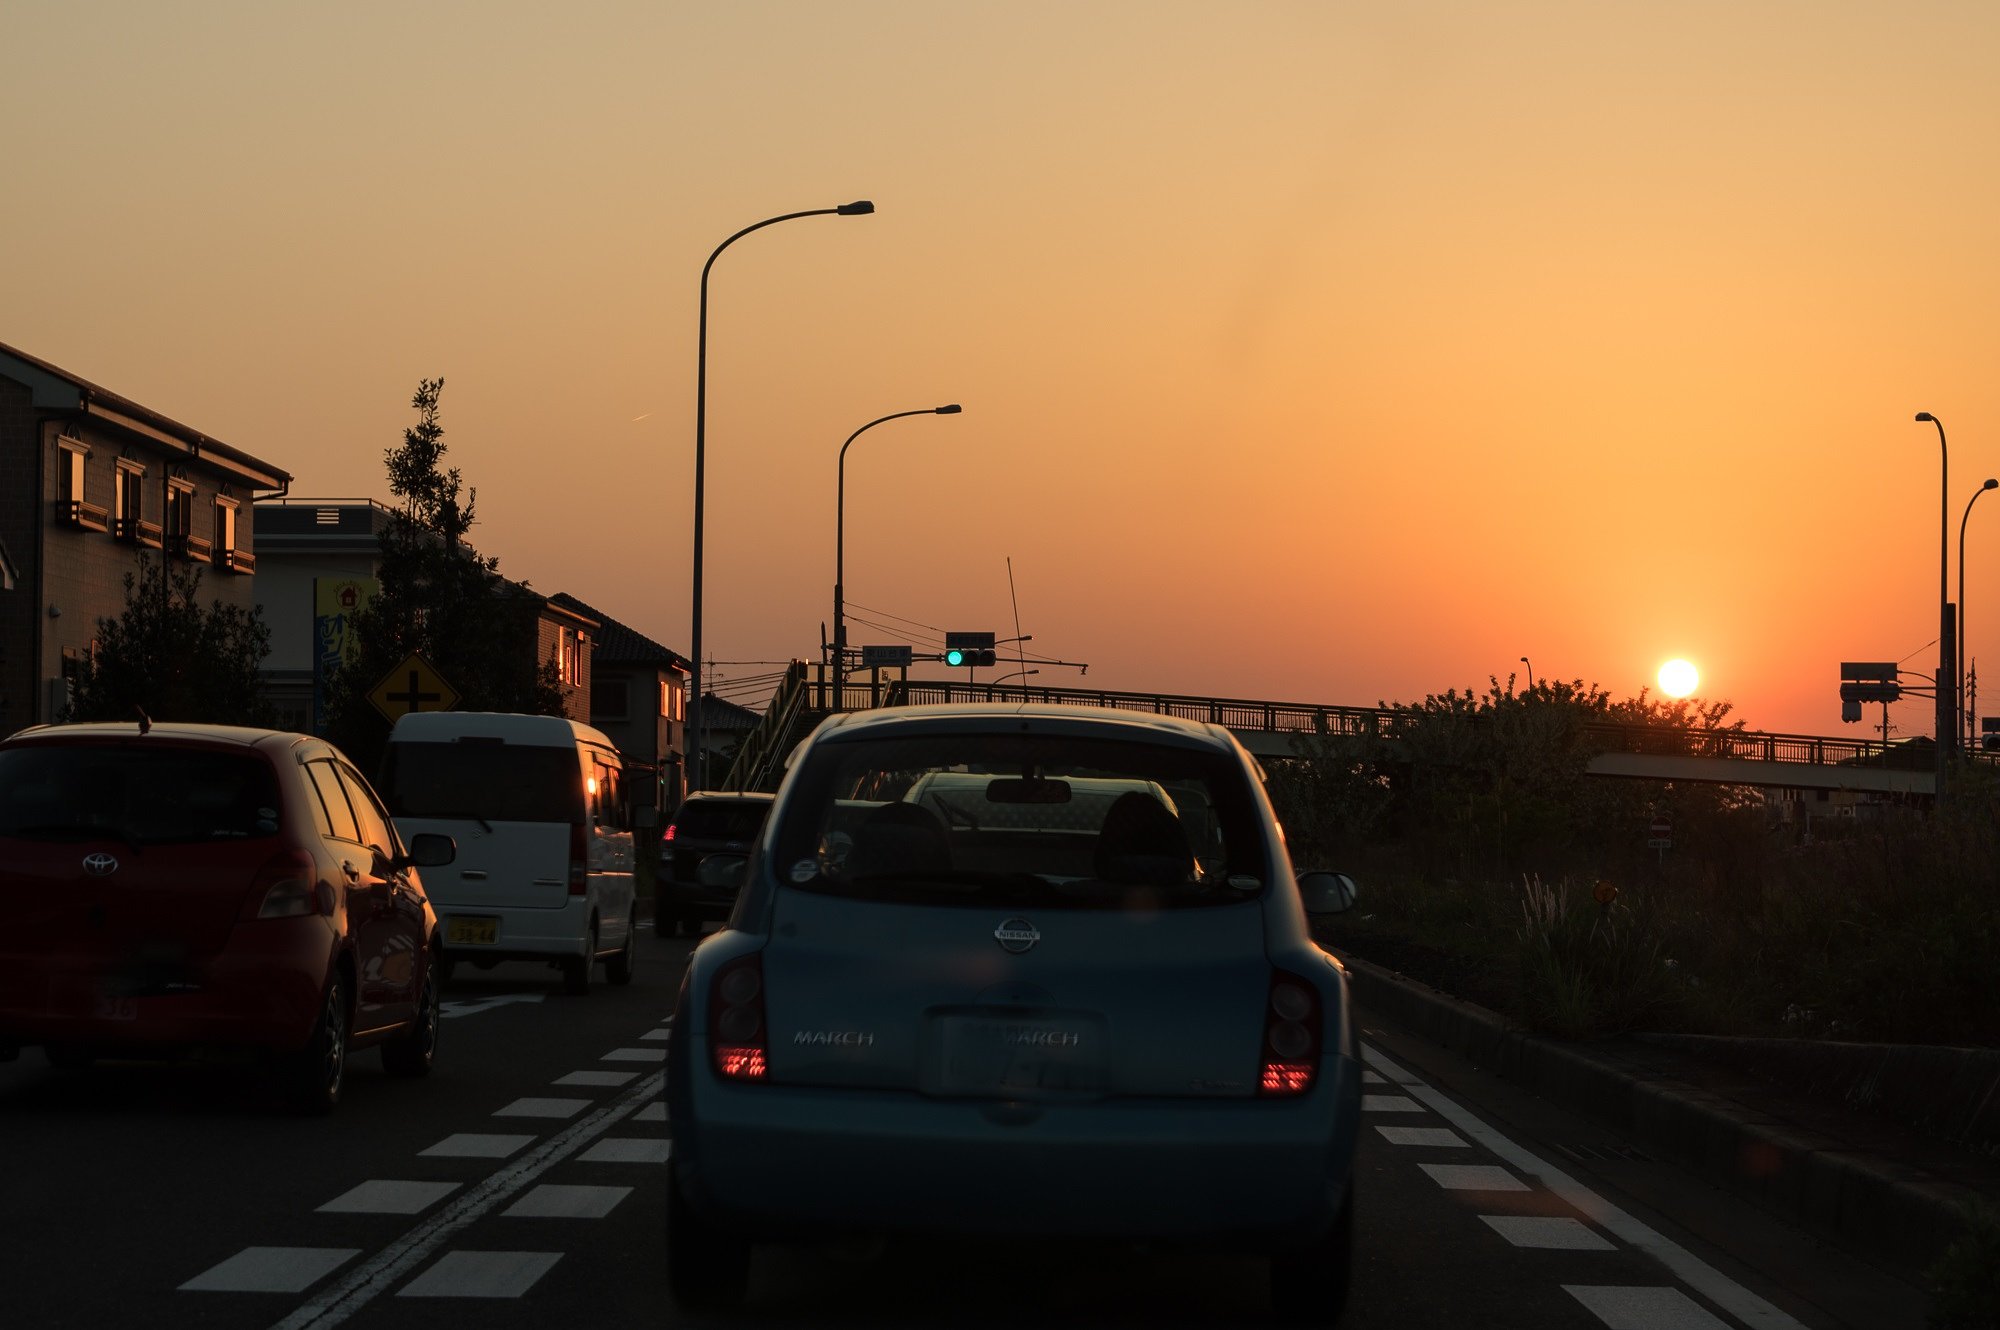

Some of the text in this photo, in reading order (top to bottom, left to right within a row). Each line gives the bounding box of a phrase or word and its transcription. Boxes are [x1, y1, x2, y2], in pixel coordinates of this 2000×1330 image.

[998, 930, 1037, 939] NISSAN
[793, 1031, 875, 1047] MARCH
[1008, 1031, 1080, 1047] ARCH
